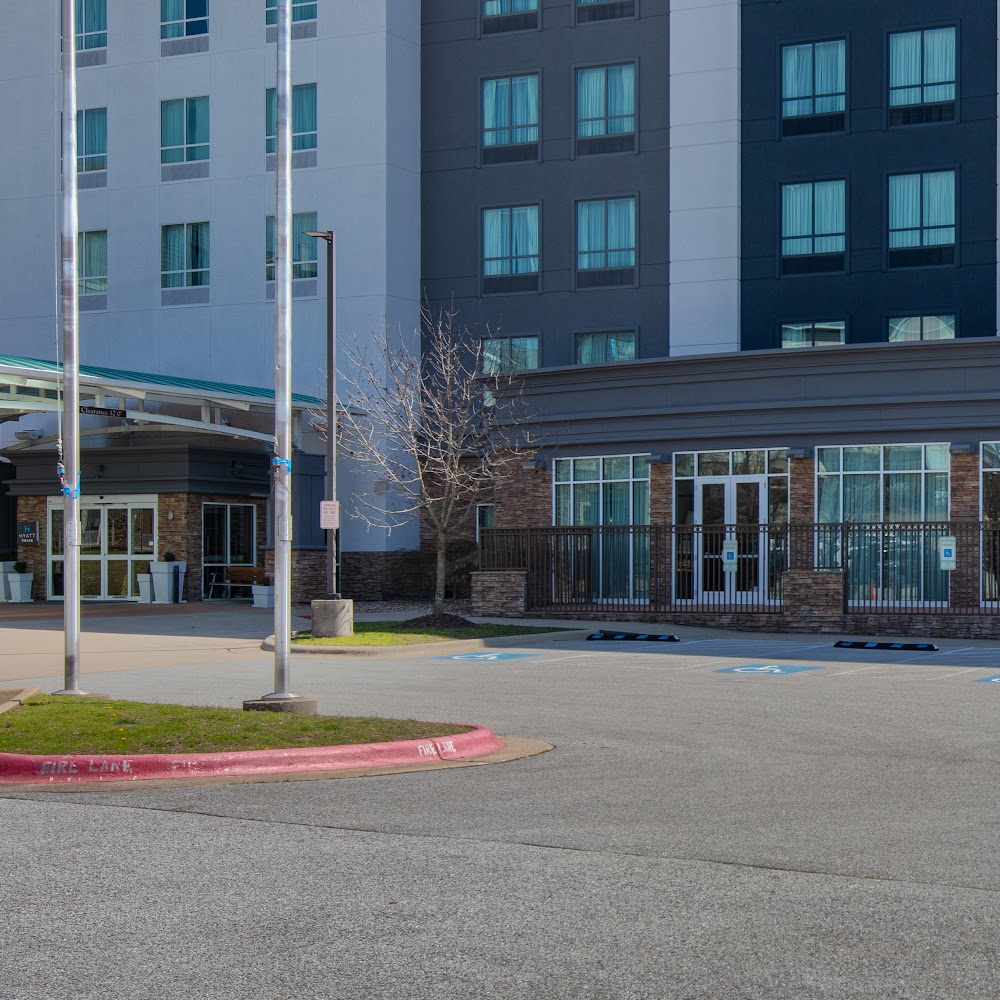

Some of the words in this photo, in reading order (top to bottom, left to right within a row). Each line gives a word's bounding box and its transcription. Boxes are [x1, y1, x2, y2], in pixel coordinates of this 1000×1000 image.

[80, 406, 108, 416] Clearance
[417, 743, 437, 757] FIRE
[40, 760, 79, 776] FIRE
[88, 759, 135, 774] LANE
